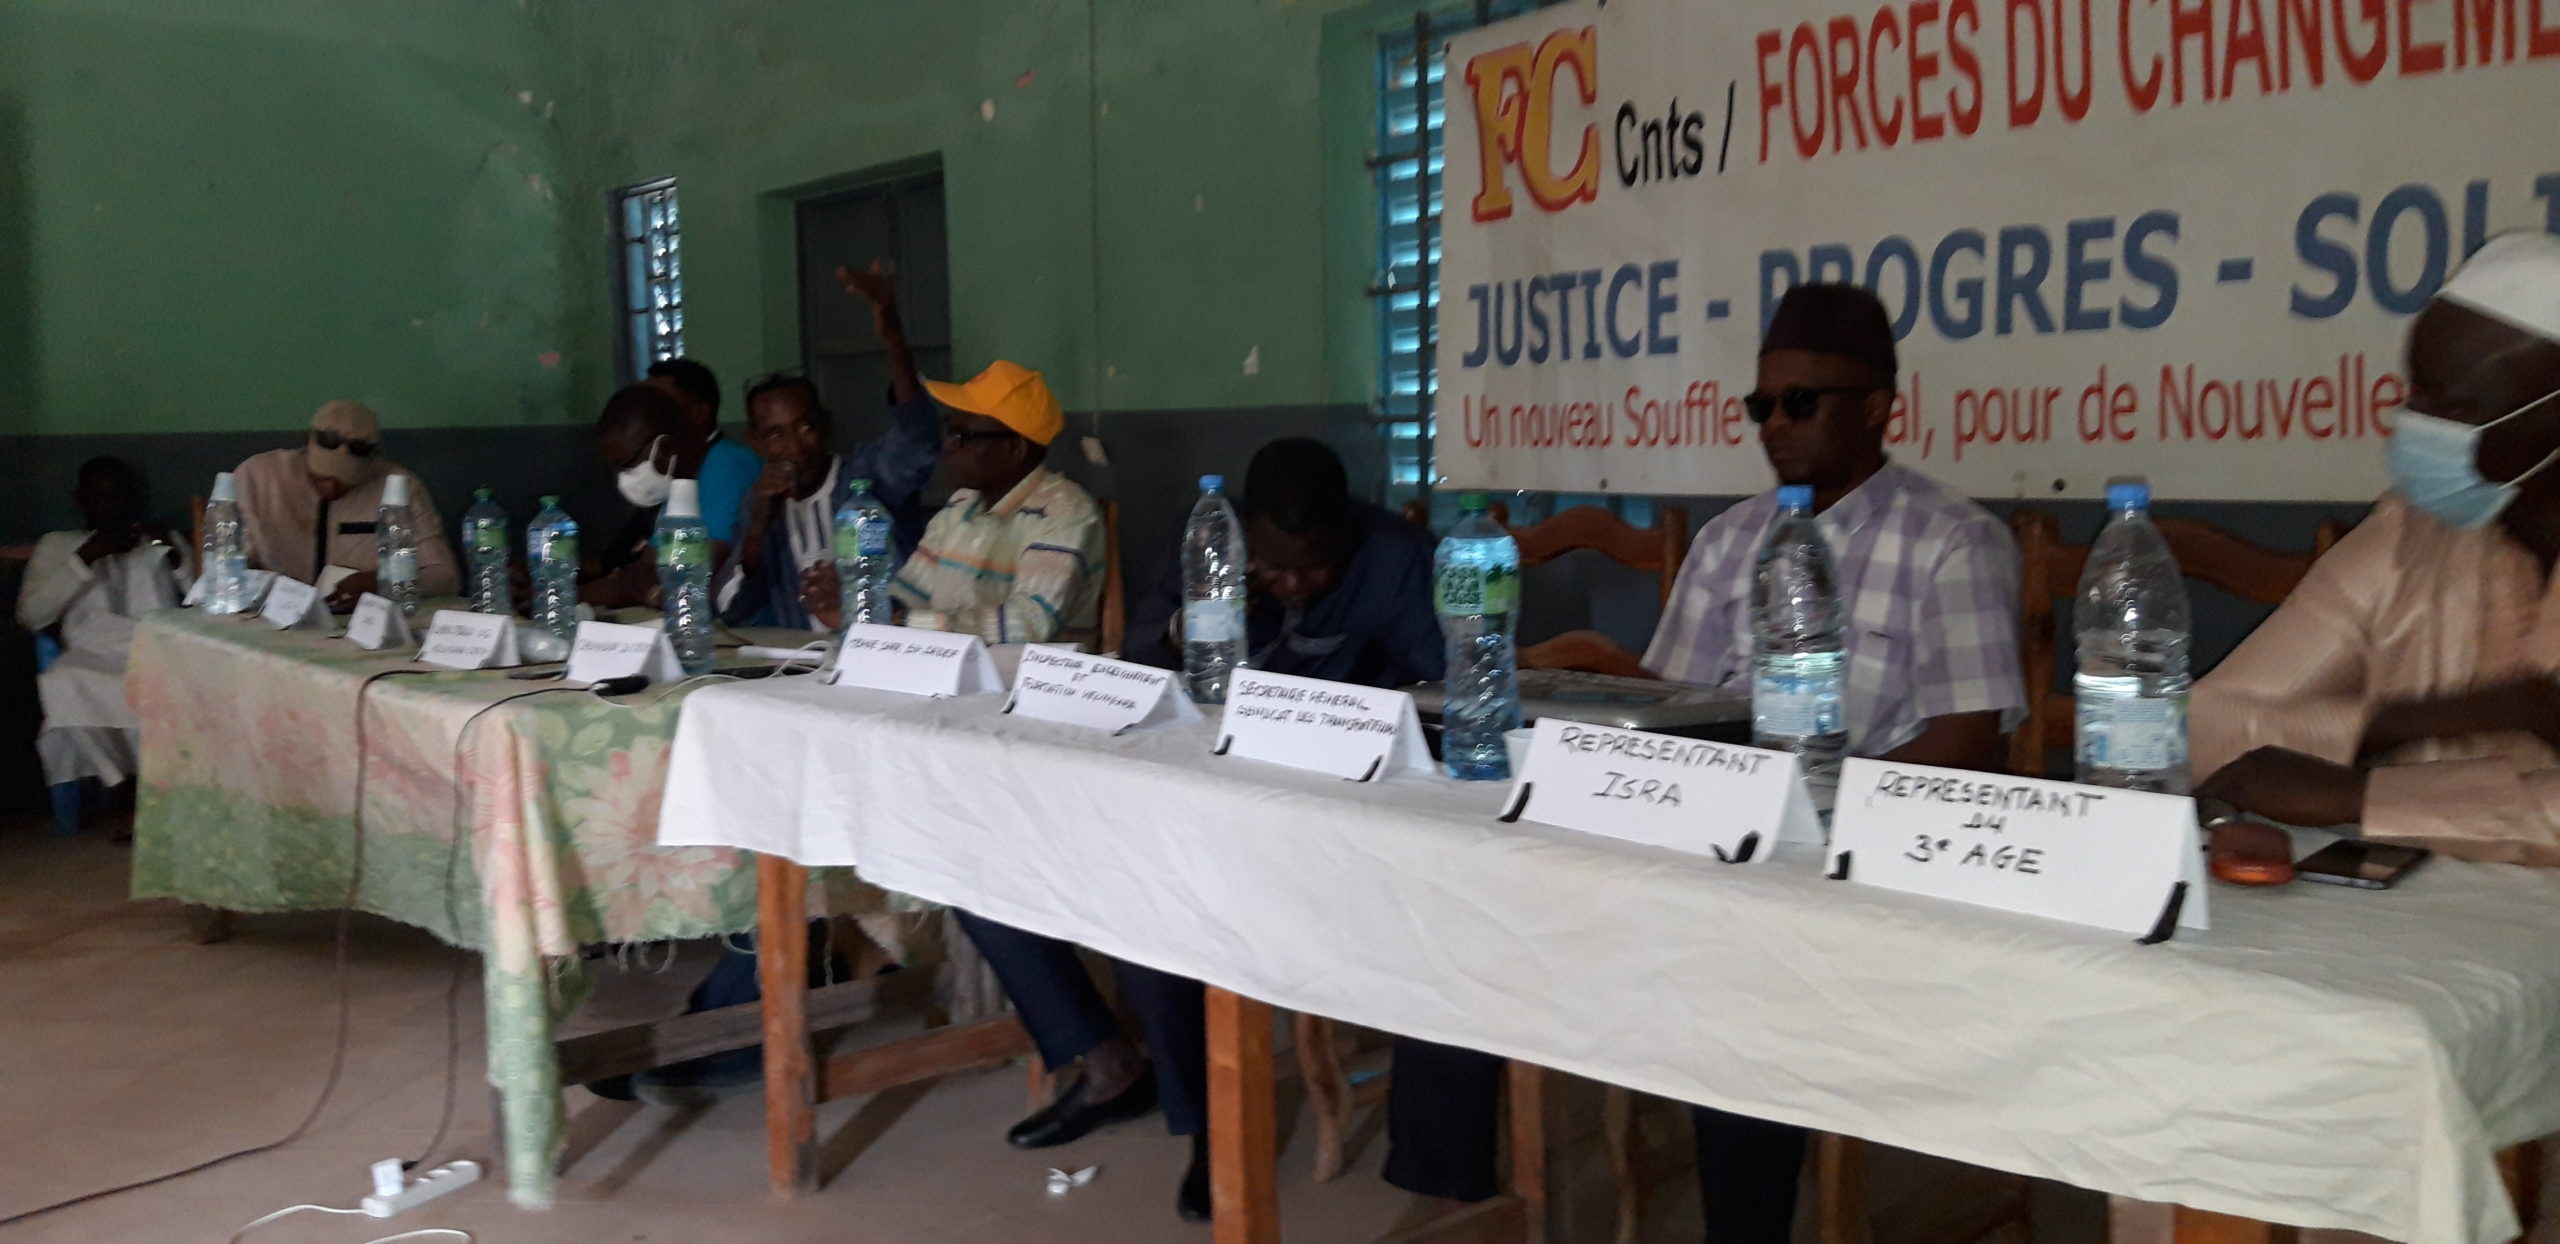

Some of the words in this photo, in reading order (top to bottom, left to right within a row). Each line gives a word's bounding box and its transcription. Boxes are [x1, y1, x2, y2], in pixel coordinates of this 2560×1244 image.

[1465, 26, 1597, 223] FC
[1615, 97, 1704, 188] Cnts
[1718, 80, 1736, 174] /
[1757, 0, 1983, 165] FORCES
[2007, 0, 2092, 128] DU
[1462, 259, 1680, 368] JUSTICE
[1707, 299, 1730, 318] -
[2217, 258, 2253, 283] -
[1463, 394, 1498, 448] Un
[1510, 396, 1613, 448] nouveau
[1624, 380, 1744, 448] Souffle
[1954, 386, 2062, 461] pour
[2077, 364, 2138, 443] de
[1557, 726, 1771, 775] REPRESENTANT
[1591, 771, 1682, 807] ISRA
[1875, 770, 2106, 818] REPRESENTANT
[1959, 843, 2045, 875] AGE
